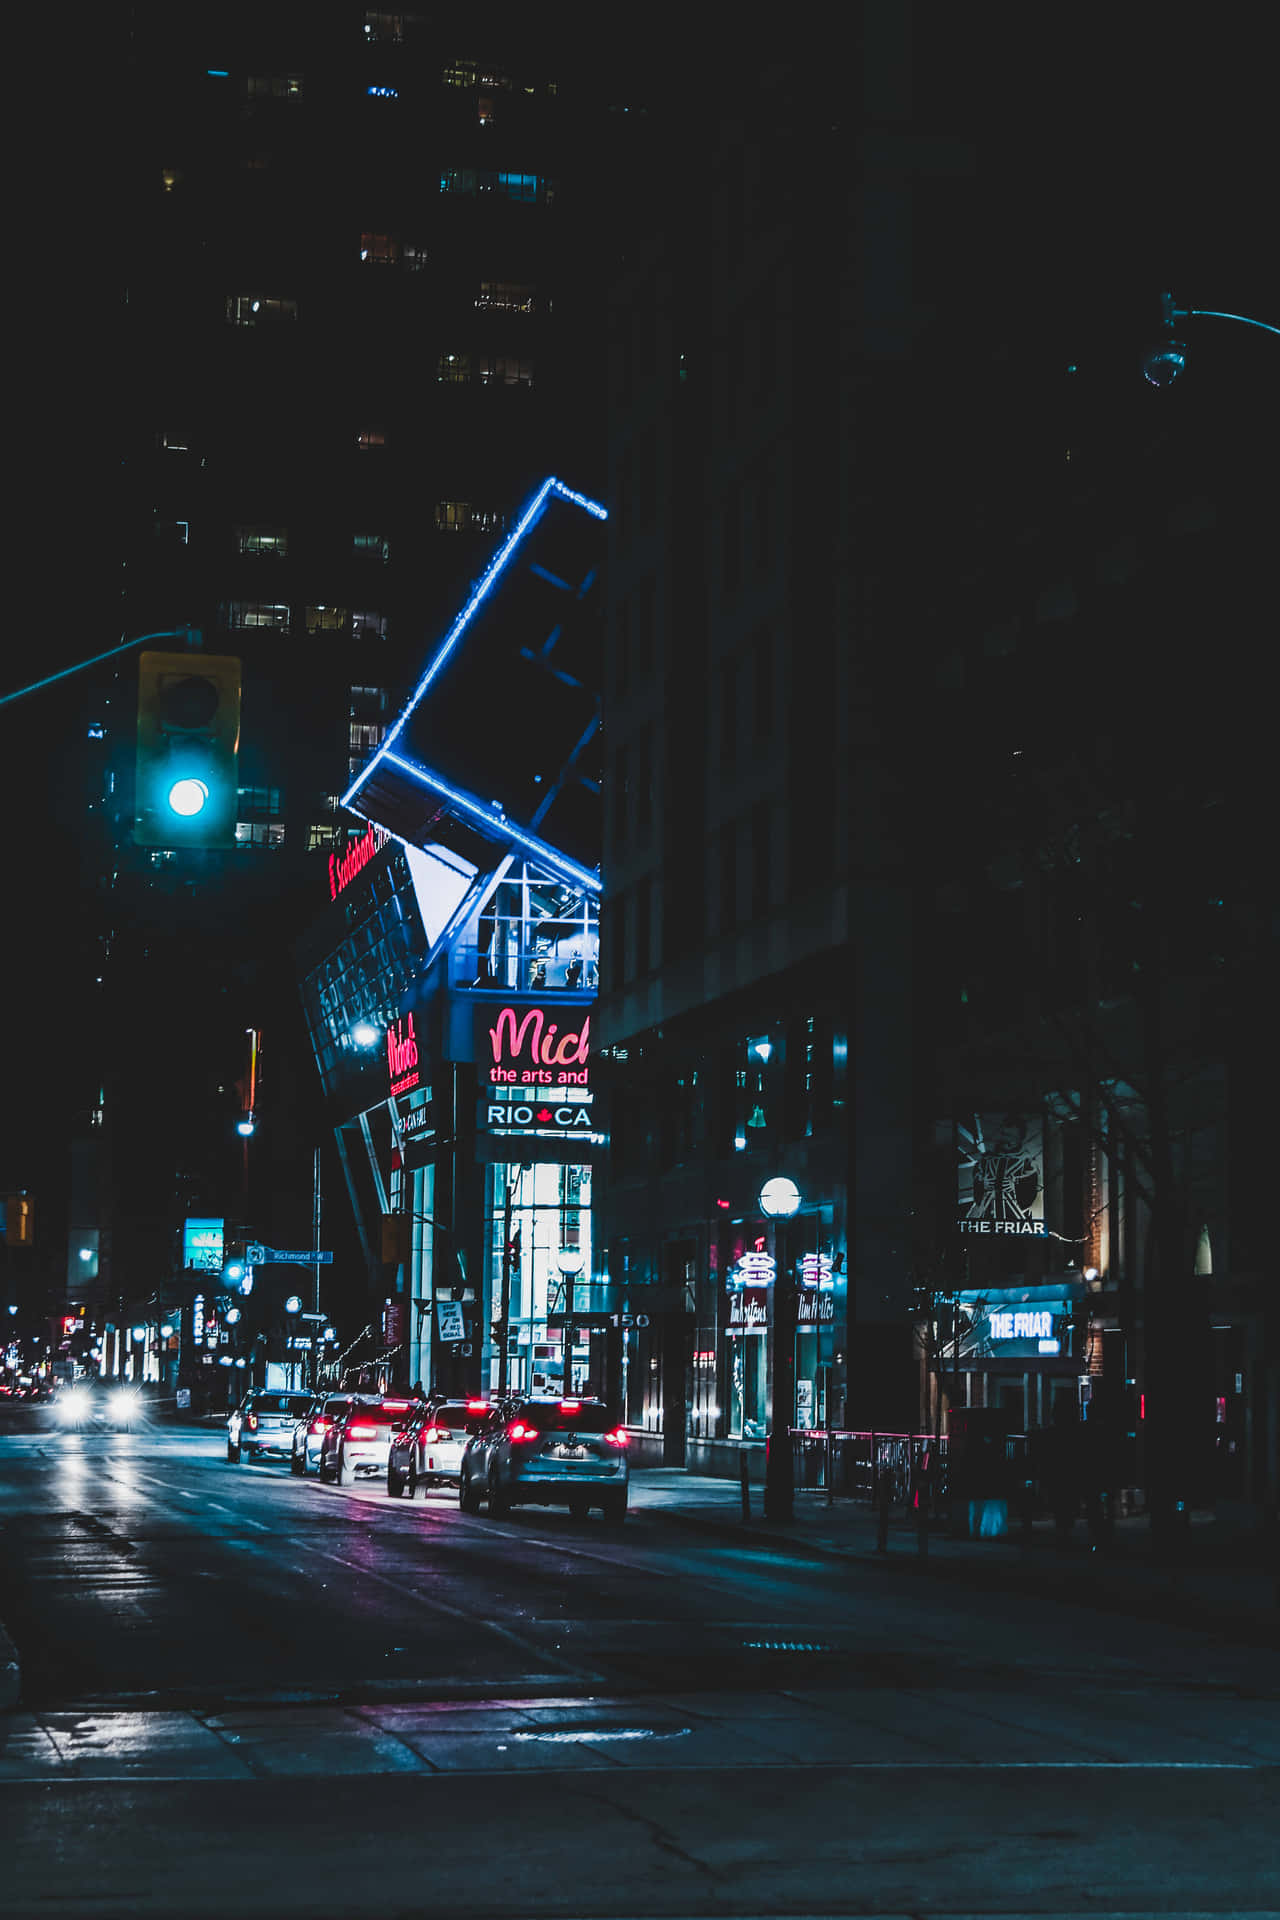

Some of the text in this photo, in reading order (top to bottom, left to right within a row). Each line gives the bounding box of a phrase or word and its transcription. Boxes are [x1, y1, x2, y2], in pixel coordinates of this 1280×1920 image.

[336, 820, 376, 893] Scotiabank
[490, 1066, 589, 1084] the arts and
[488, 1106, 533, 1124] RIO
[957, 1220, 1045, 1234] THE FRIAR
[274, 1252, 324, 1260] Richmond W
[609, 1313, 650, 1328] 150
[989, 1311, 1053, 1339] THE FRIAR
